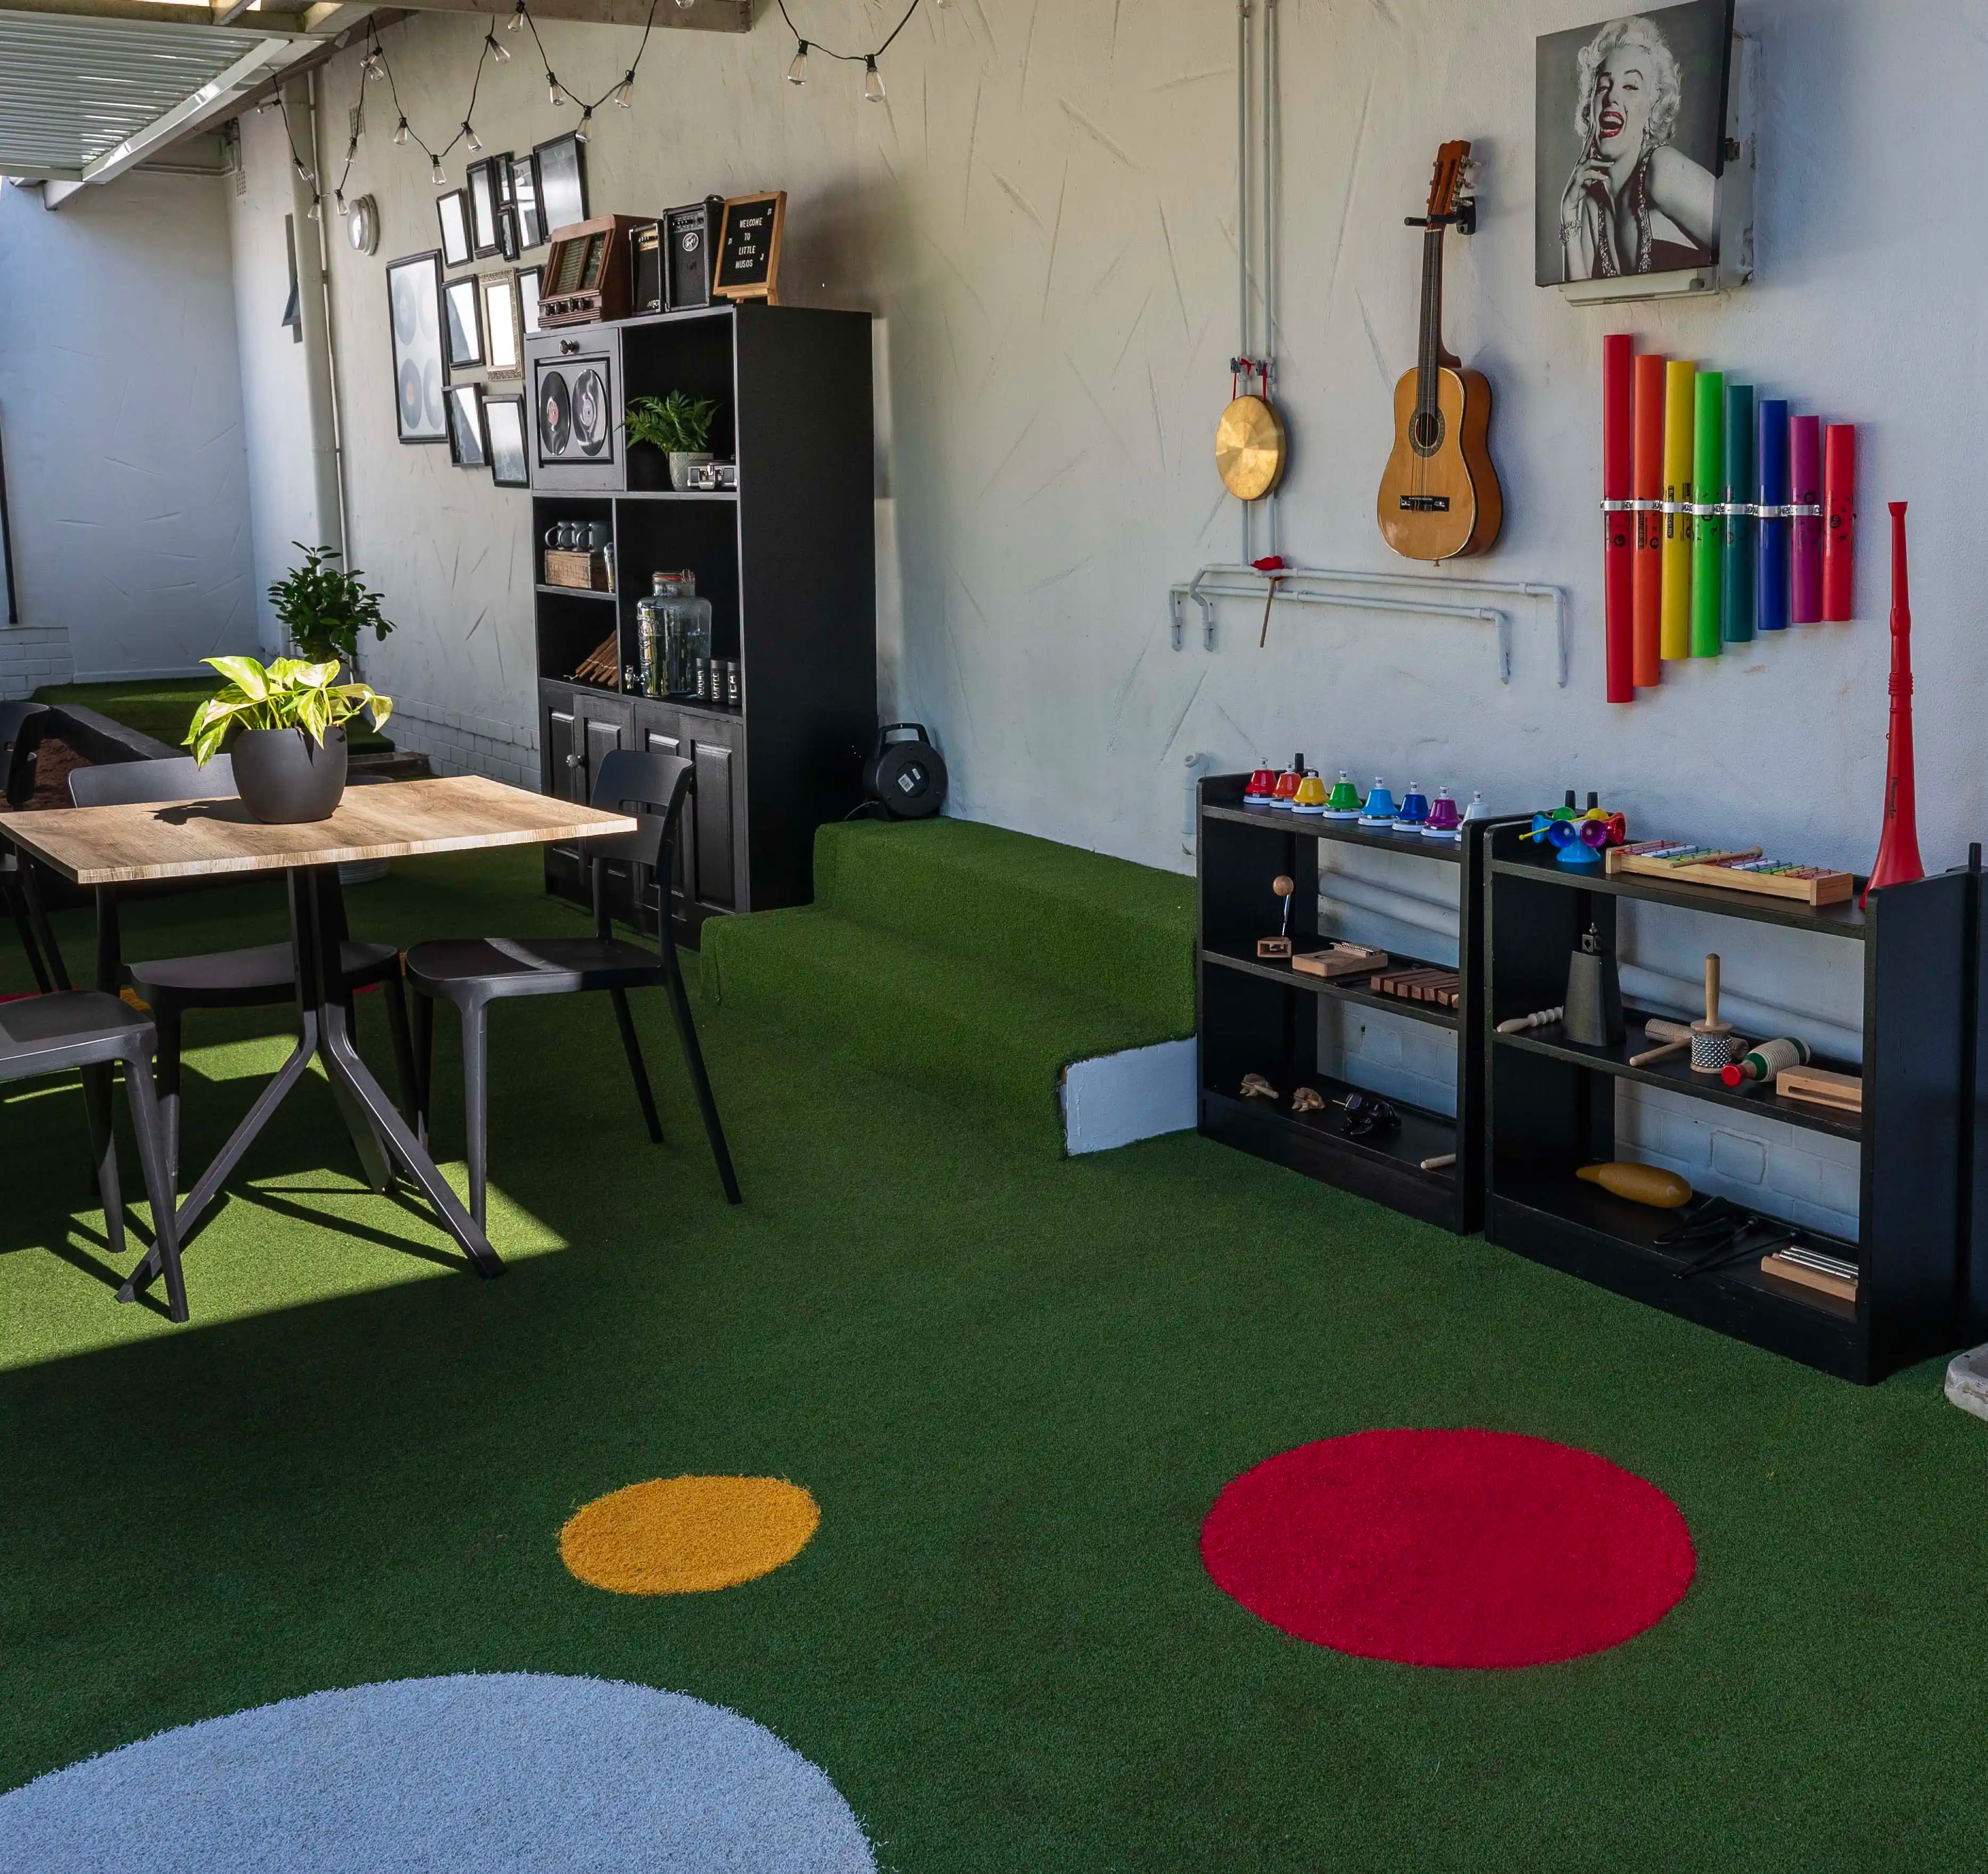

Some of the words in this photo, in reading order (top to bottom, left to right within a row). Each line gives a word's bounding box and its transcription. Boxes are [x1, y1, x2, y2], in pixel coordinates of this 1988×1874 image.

[740, 217, 763, 228] WELCOME
[744, 233, 751, 241] TO
[738, 245, 756, 255] LITTLE
[735, 259, 753, 269] MUSOS
